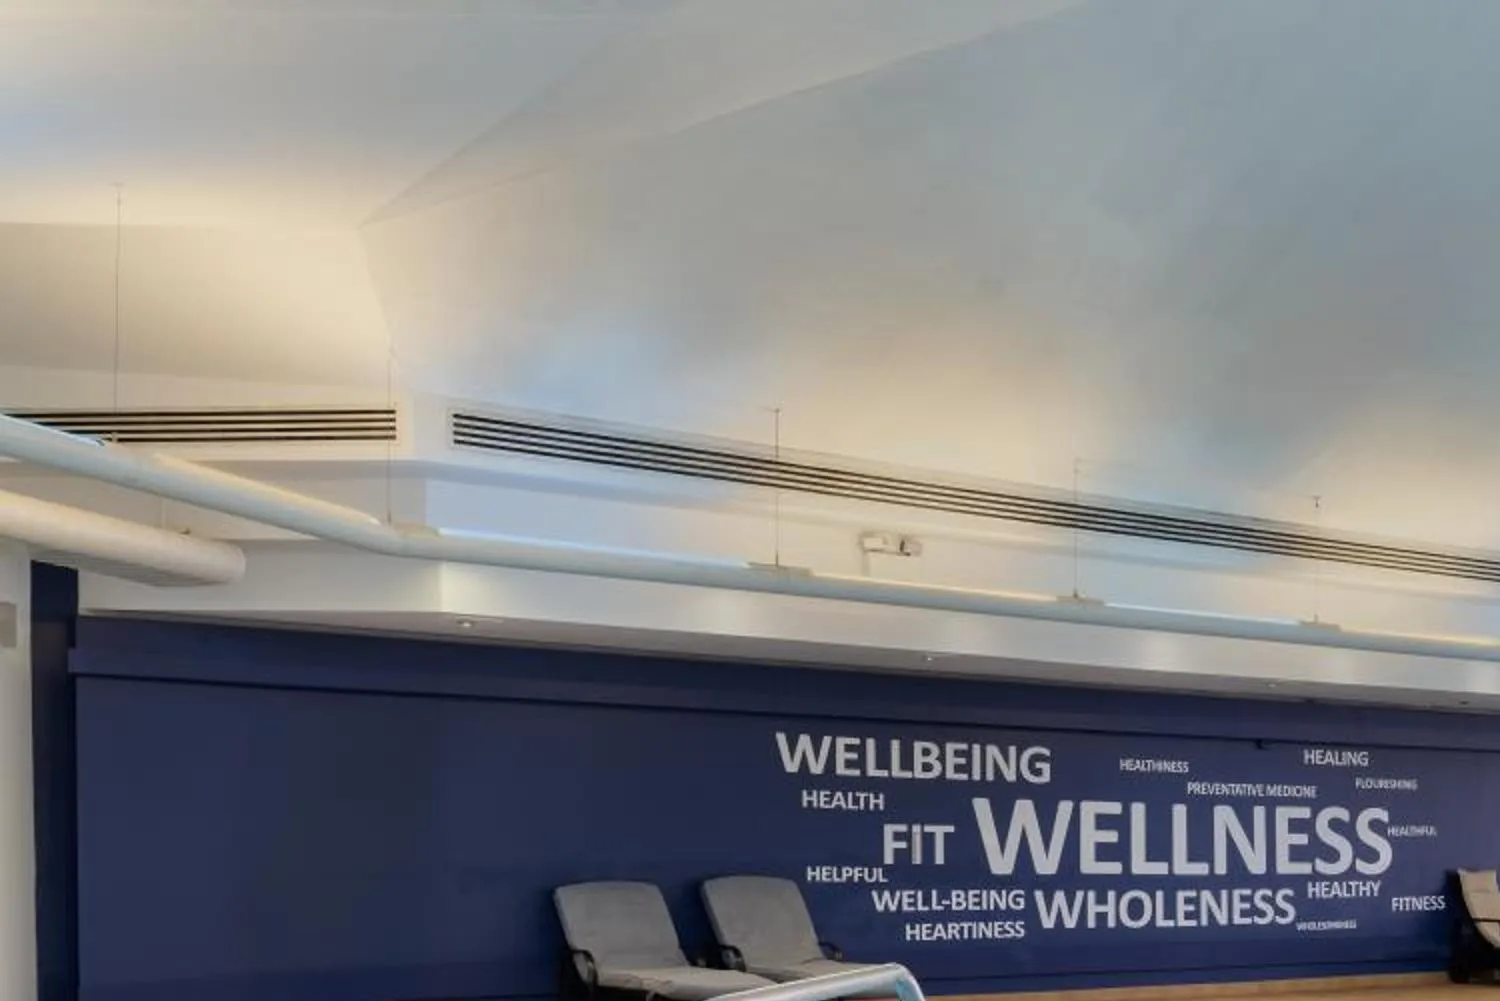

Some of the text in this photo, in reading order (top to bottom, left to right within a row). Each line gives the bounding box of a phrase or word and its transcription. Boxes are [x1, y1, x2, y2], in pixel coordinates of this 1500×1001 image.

[775, 731, 1051, 784] WELLBEING
[1119, 758, 1189, 774] HEALTHINESS
[1303, 748, 1369, 767] HEALING
[801, 789, 885, 811] HEALTH
[1186, 781, 1317, 799] PREVENTATIVE MEDICINE
[883, 823, 955, 865] FIT
[971, 796, 1393, 876] WELLNESS
[806, 865, 888, 883] HELPFUL
[1307, 879, 1381, 899] HEALTHY
[871, 889, 1025, 912] WELL-BEING
[1033, 887, 1296, 930] WHOLENESS
[1391, 895, 1446, 912] FITNESS
[905, 920, 1025, 941] HEARTINESS
